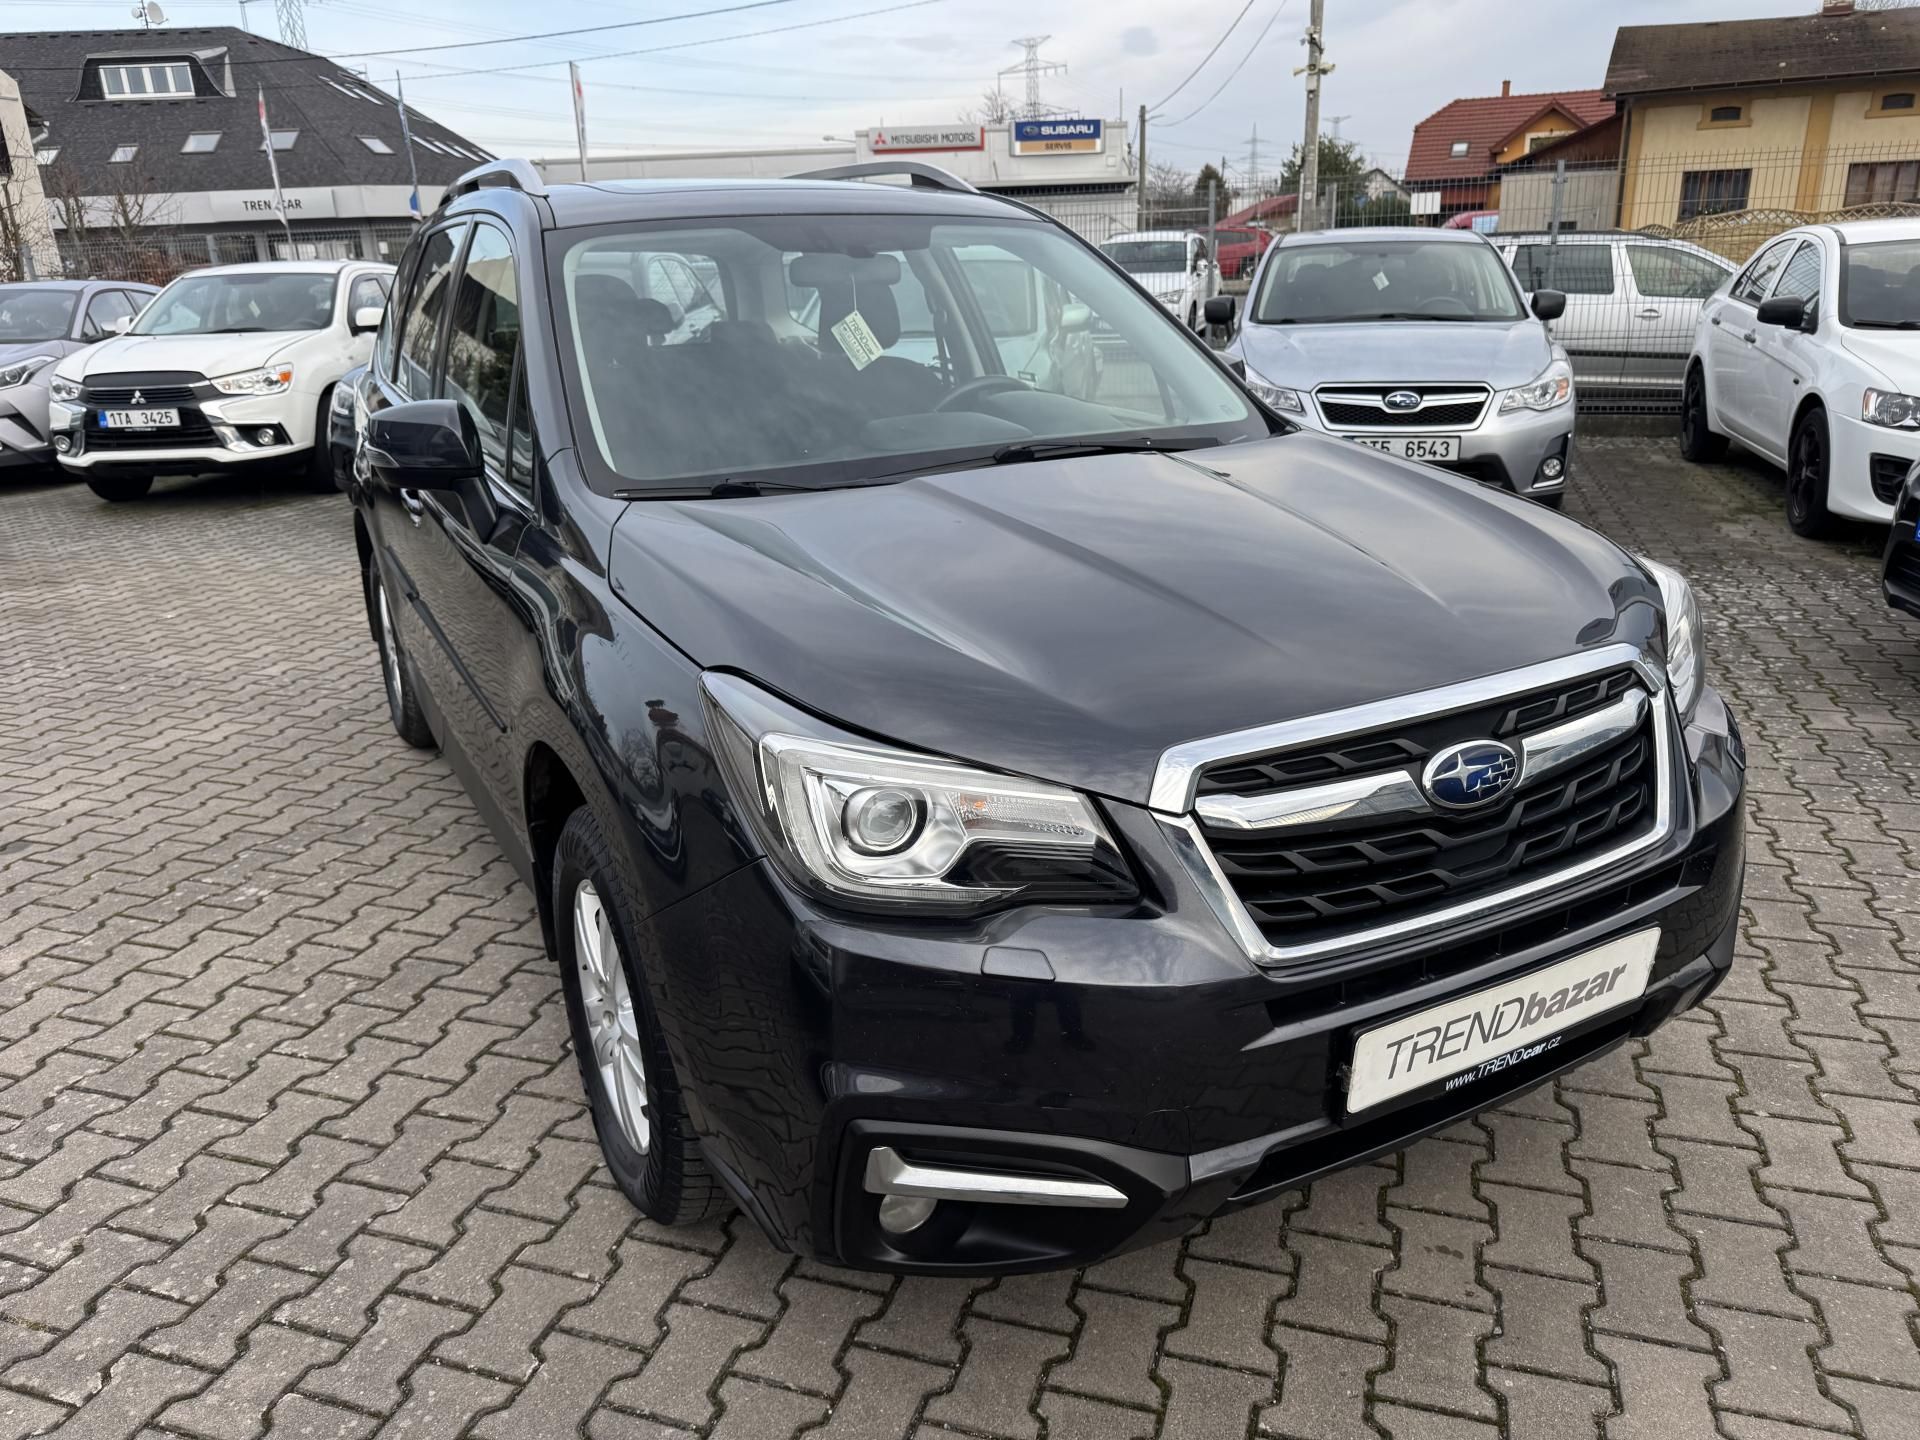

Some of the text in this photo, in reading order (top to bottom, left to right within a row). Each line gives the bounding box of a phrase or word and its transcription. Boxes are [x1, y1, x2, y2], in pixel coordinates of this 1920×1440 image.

[1040, 125, 1094, 136] SUBARU
[890, 132, 975, 145] MITSUBISHI MOTORS
[1045, 142, 1072, 151] SERVIS
[109, 412, 132, 425] 1TA
[141, 411, 173, 425] 3425
[1404, 440, 1450, 458] 6543
[1386, 963, 1627, 1080] TRENDbazar
[1445, 1036, 1562, 1091] www.TRENDcar.cz
